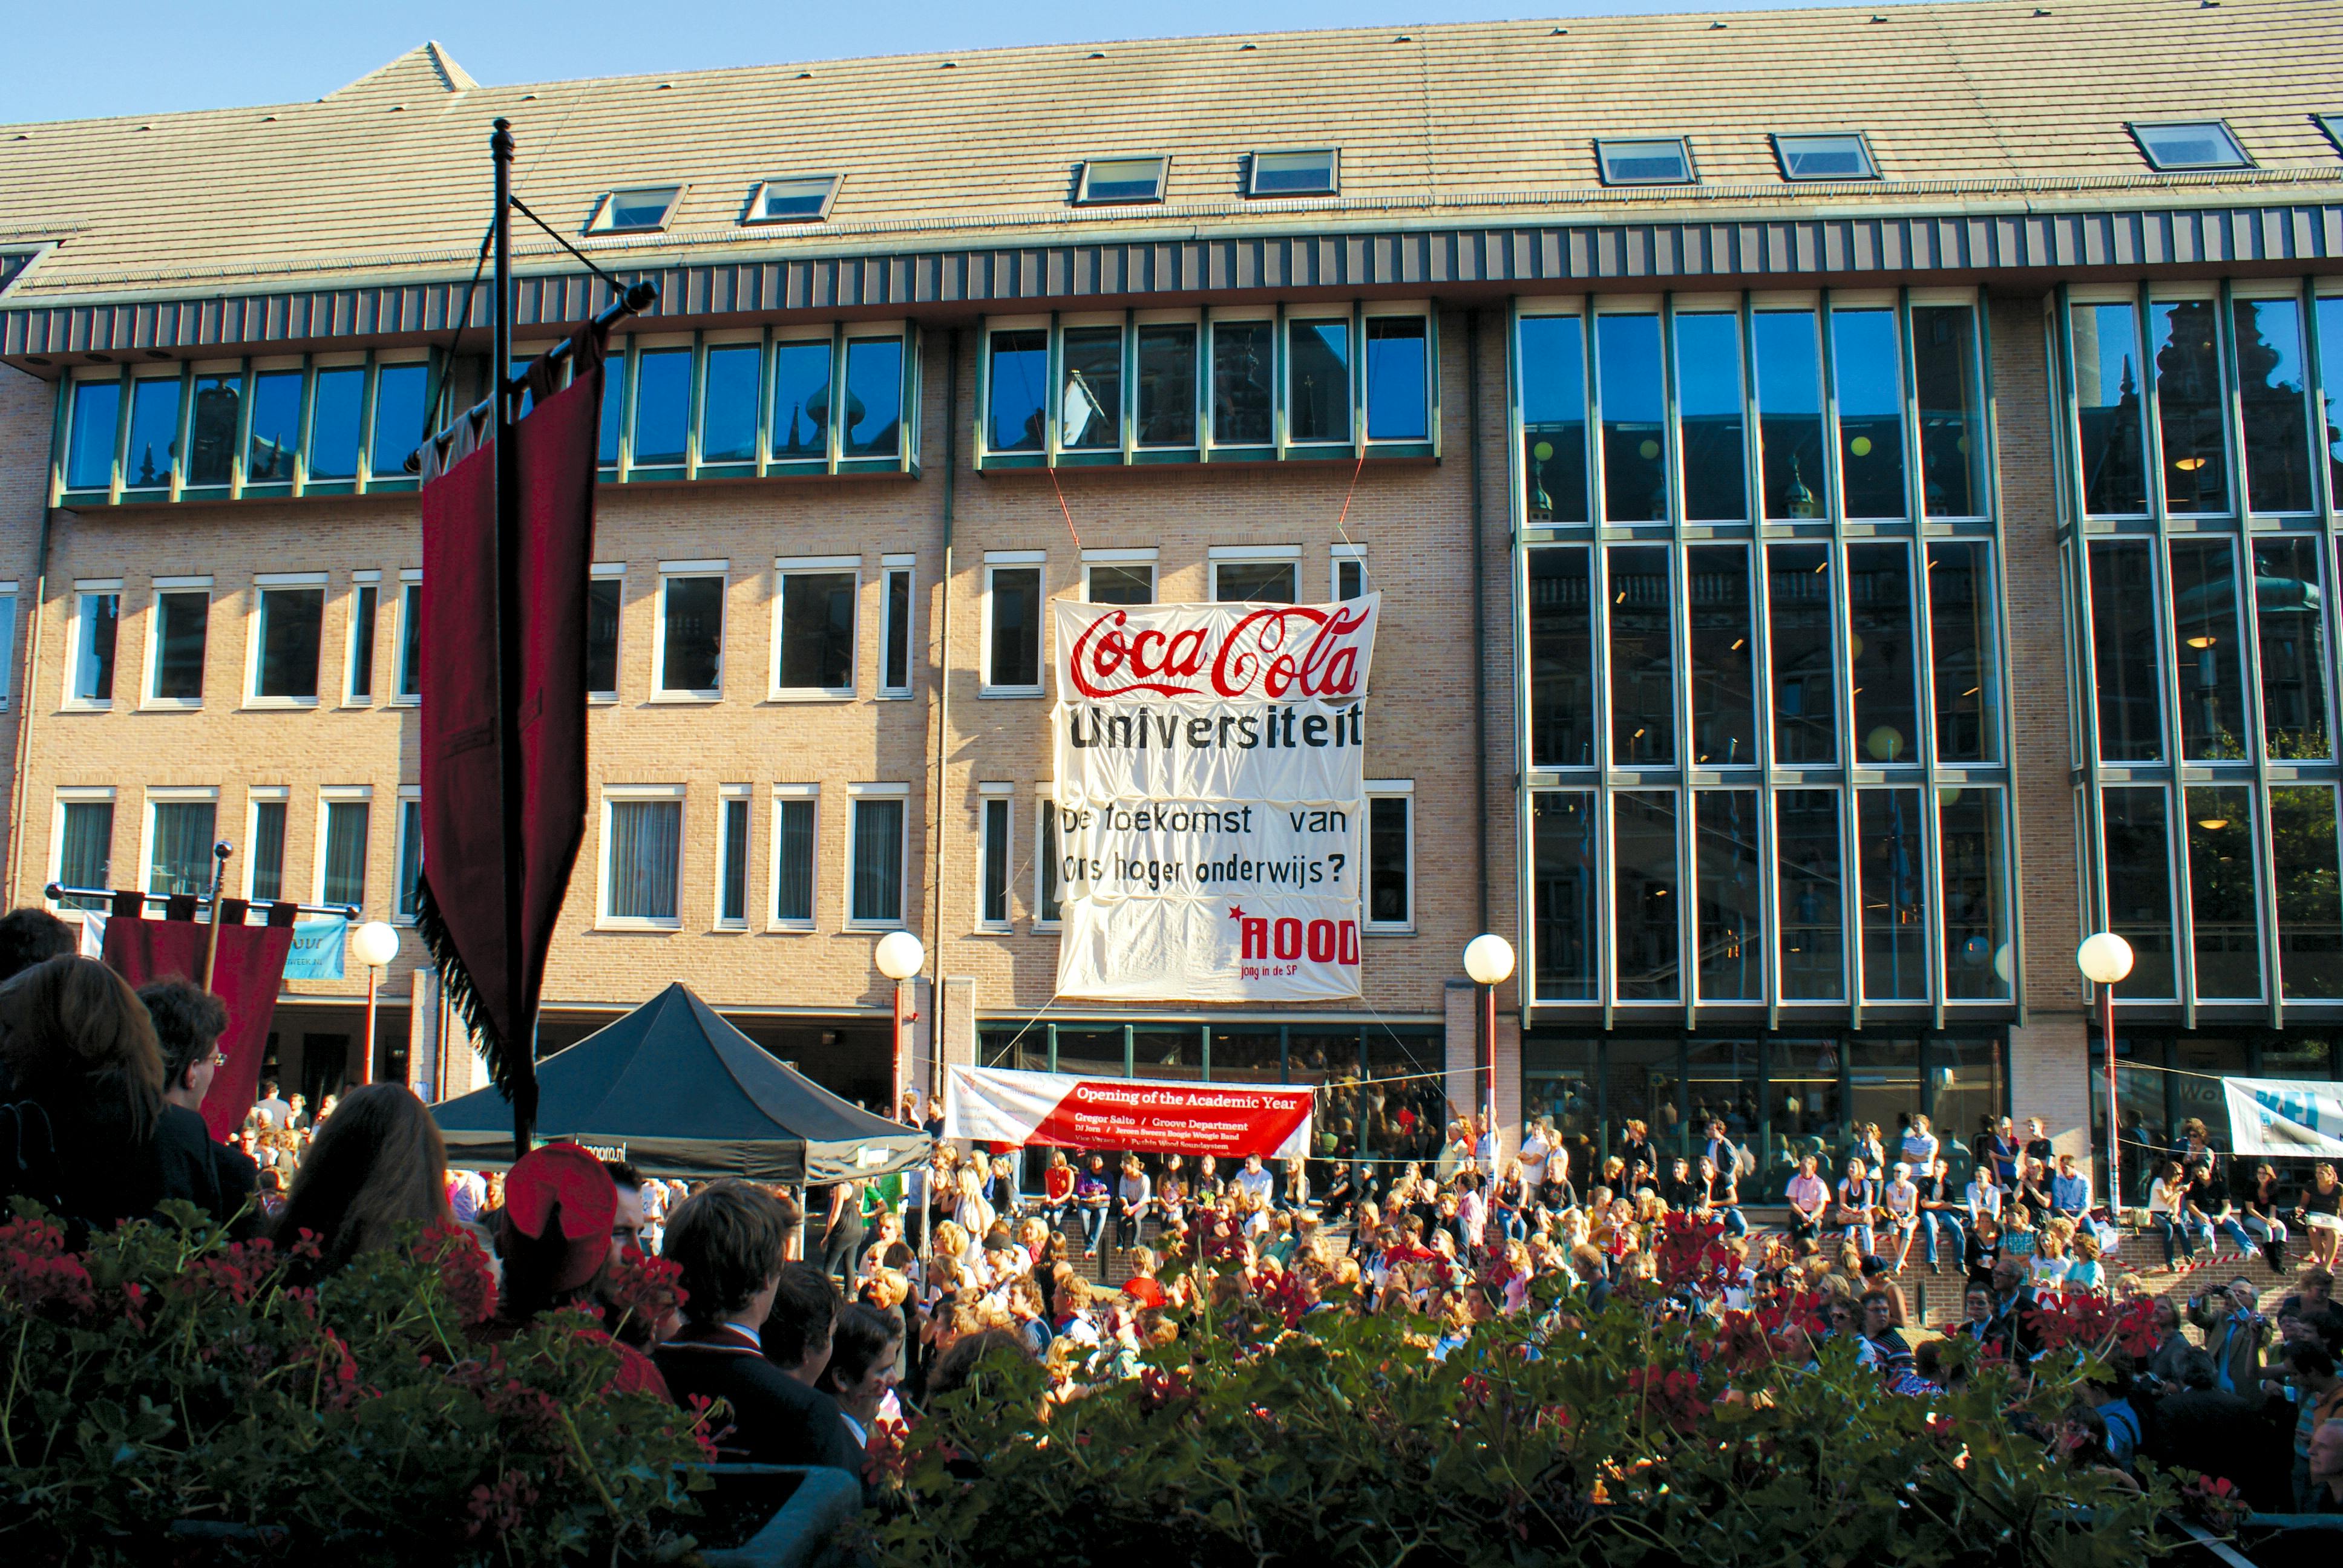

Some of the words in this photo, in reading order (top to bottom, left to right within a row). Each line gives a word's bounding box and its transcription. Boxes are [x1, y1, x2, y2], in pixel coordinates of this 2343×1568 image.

[1071, 610, 1208, 697] Coca
[1211, 606, 1370, 697] Cola
[1071, 705, 1363, 748] Universiteit
[1063, 808, 1091, 833] De
[1106, 802, 1252, 834] toekomst
[1289, 810, 1346, 833] van
[1115, 852, 1183, 891] hoger
[1196, 853, 1345, 889] onderwijs?
[1242, 917, 1359, 965] ROOD
[1240, 965, 1259, 980] jong
[1262, 966, 1270, 976] in
[1273, 965, 1283, 976] de
[1286, 965, 1297, 976] SP
[1077, 1087, 1140, 1106] Opening
[1142, 1091, 1158, 1103] of
[1160, 1091, 1184, 1105] the
[1186, 1094, 1260, 1109] Academic
[1262, 1096, 1297, 1109] Year
[1075, 1112, 1109, 1124] Gregor
[1110, 1115, 1135, 1125] Salto
[1152, 1118, 1187, 1128] Groove
[1188, 1120, 1248, 1131] Department
[1116, 1127, 1139, 1135] Jeroen
[1167, 1130, 1191, 1139] Boogie
[1193, 1131, 1219, 1140] Woogie
[1180, 1141, 1228, 1150] Soundsystem
